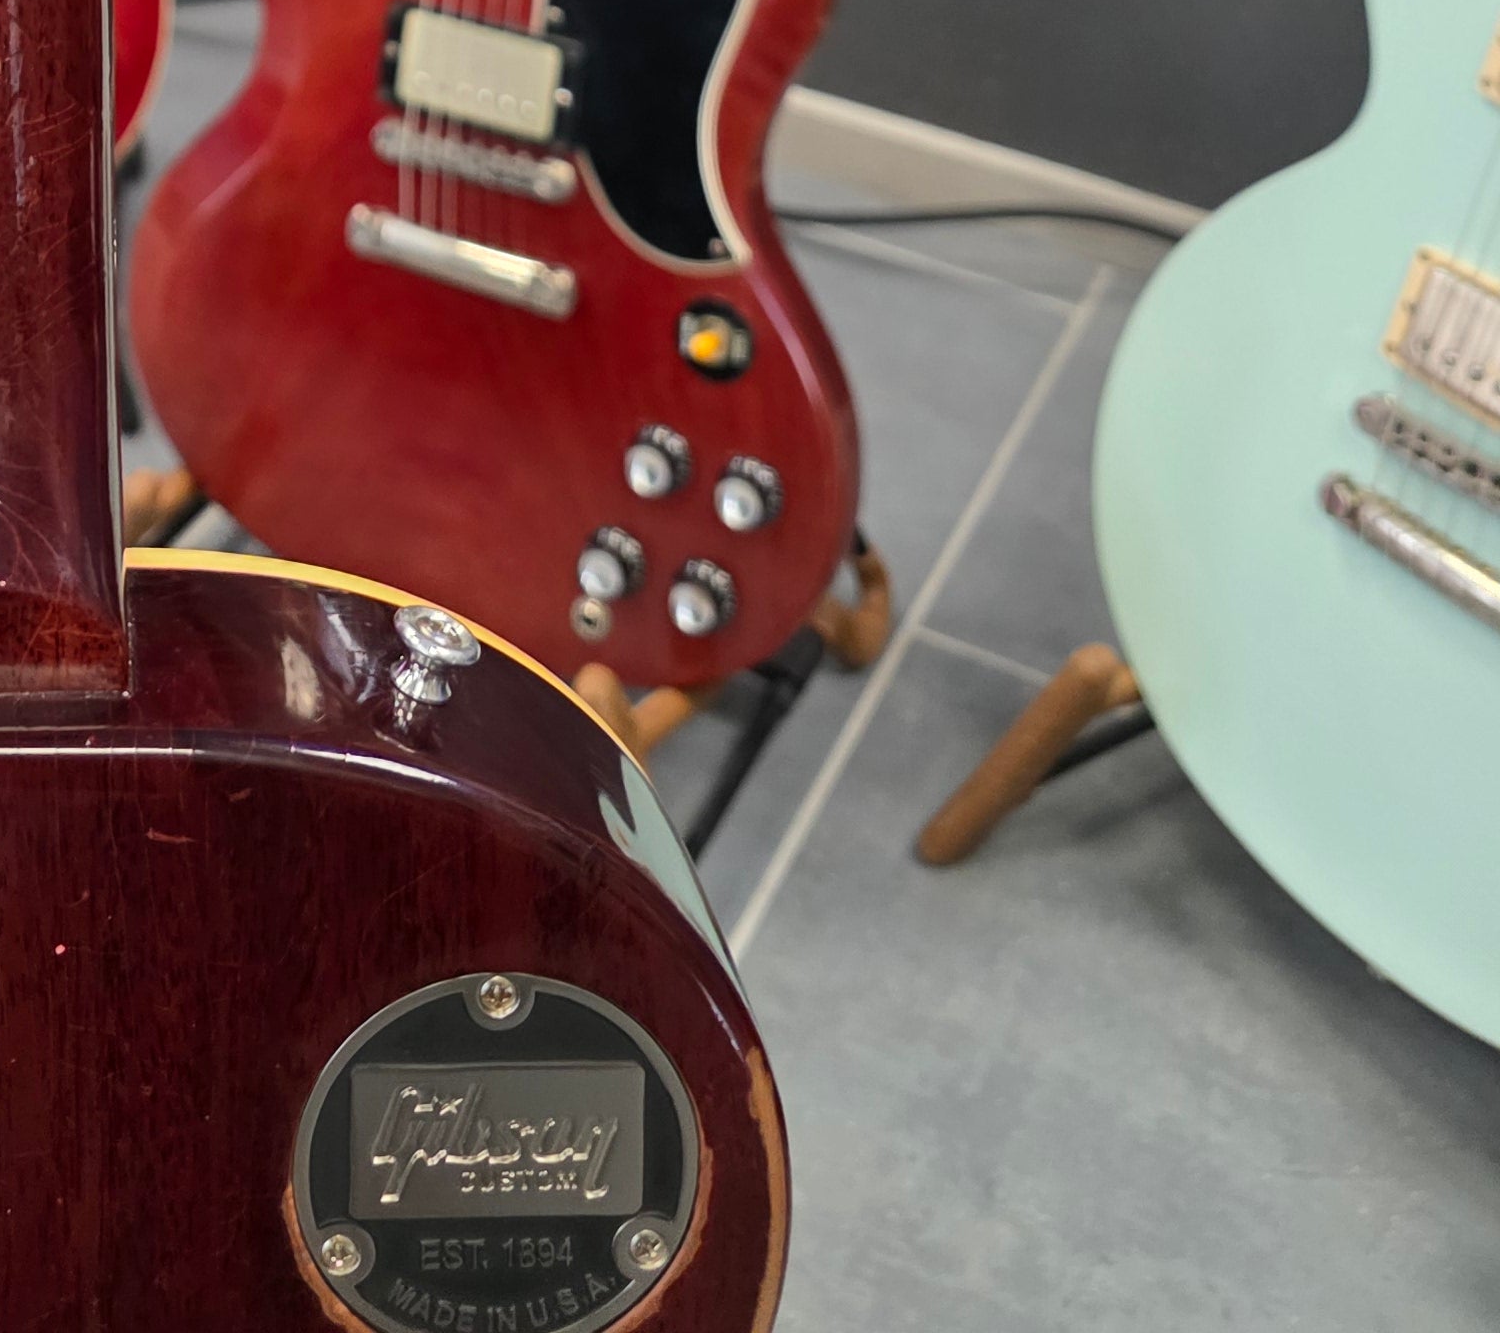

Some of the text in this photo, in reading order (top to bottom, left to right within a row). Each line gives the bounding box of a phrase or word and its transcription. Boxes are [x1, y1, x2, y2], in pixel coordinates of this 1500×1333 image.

[371, 1082, 619, 1203] Gibson
[459, 1169, 578, 1193] CUSTOM
[419, 1236, 574, 1270] EST. 1894
[387, 1278, 478, 1333] MADE
[486, 1304, 517, 1333] IN
